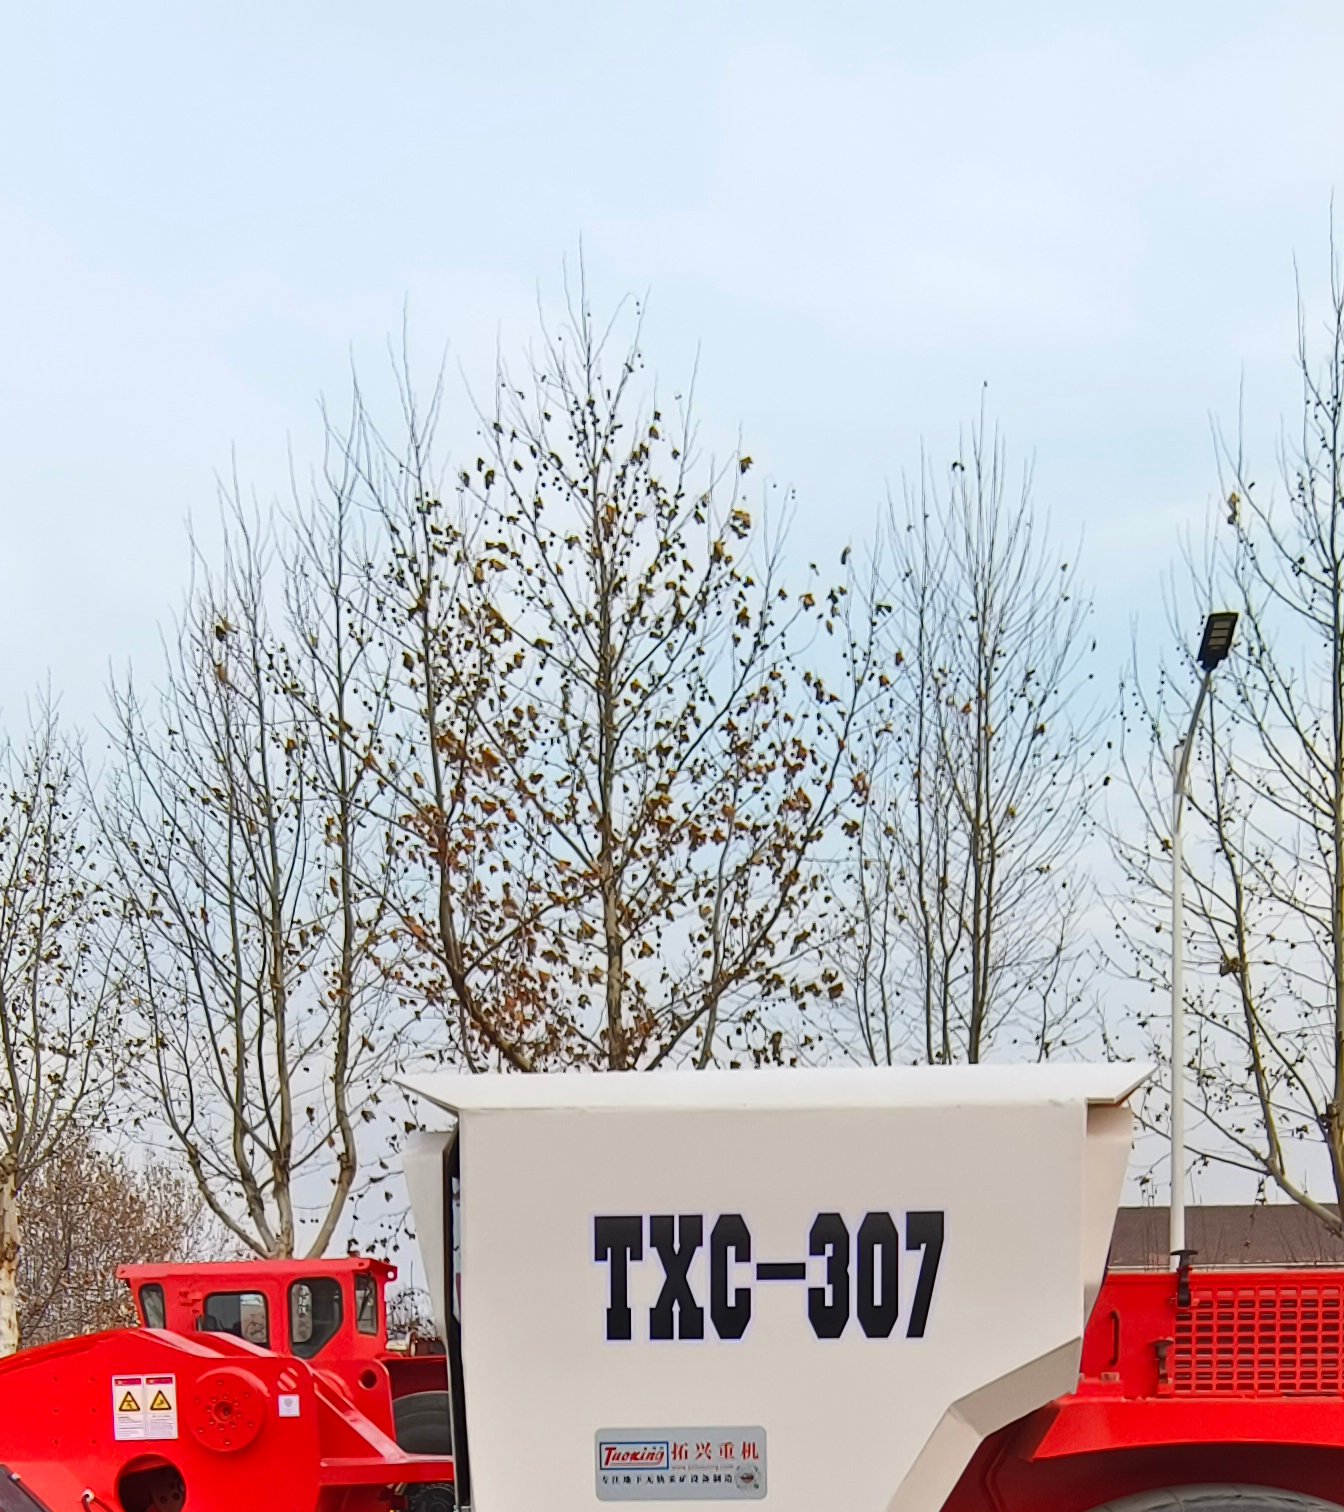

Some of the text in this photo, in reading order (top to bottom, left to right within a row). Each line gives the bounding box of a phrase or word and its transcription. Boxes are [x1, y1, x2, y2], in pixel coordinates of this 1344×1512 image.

[594, 1211, 945, 1341] TXC-307
[671, 1440, 759, 1461] 拓兴重机
